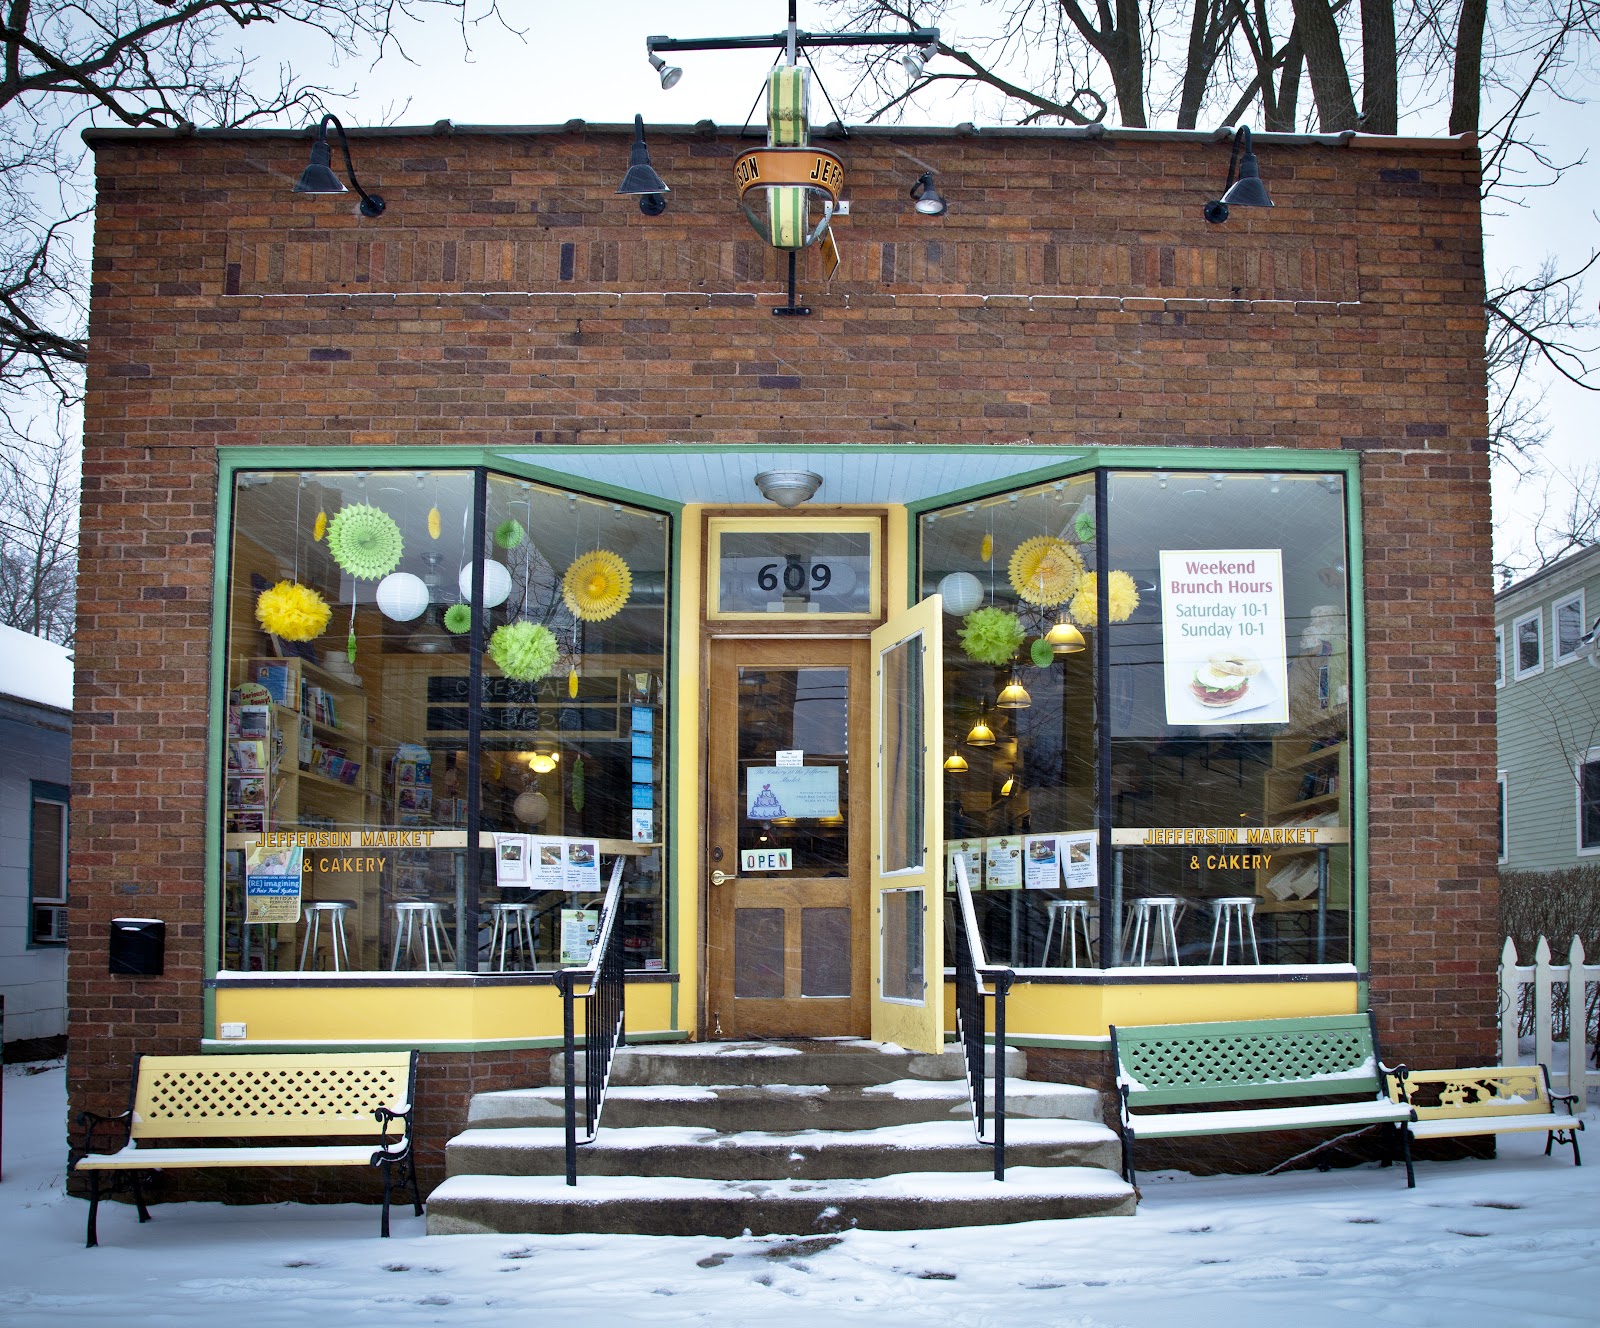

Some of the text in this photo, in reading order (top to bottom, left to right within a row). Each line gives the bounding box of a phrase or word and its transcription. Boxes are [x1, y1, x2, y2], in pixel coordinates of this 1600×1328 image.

[1185, 560, 1255, 575] Weekend
[757, 563, 831, 591] 609
[1171, 579, 1273, 594] Brunch Hours
[1176, 602, 1268, 619] Saturday 10-1
[1181, 622, 1264, 638] Sunday 10-1
[256, 831, 434, 848] JEFFERSON MARKET
[1143, 828, 1318, 845] JEFFERSON MARKET
[303, 857, 387, 873] & CAKERY
[747, 852, 788, 868] OPEN
[1190, 855, 1272, 870] & CAKERY
[248, 880, 300, 889] (RE) imagining
